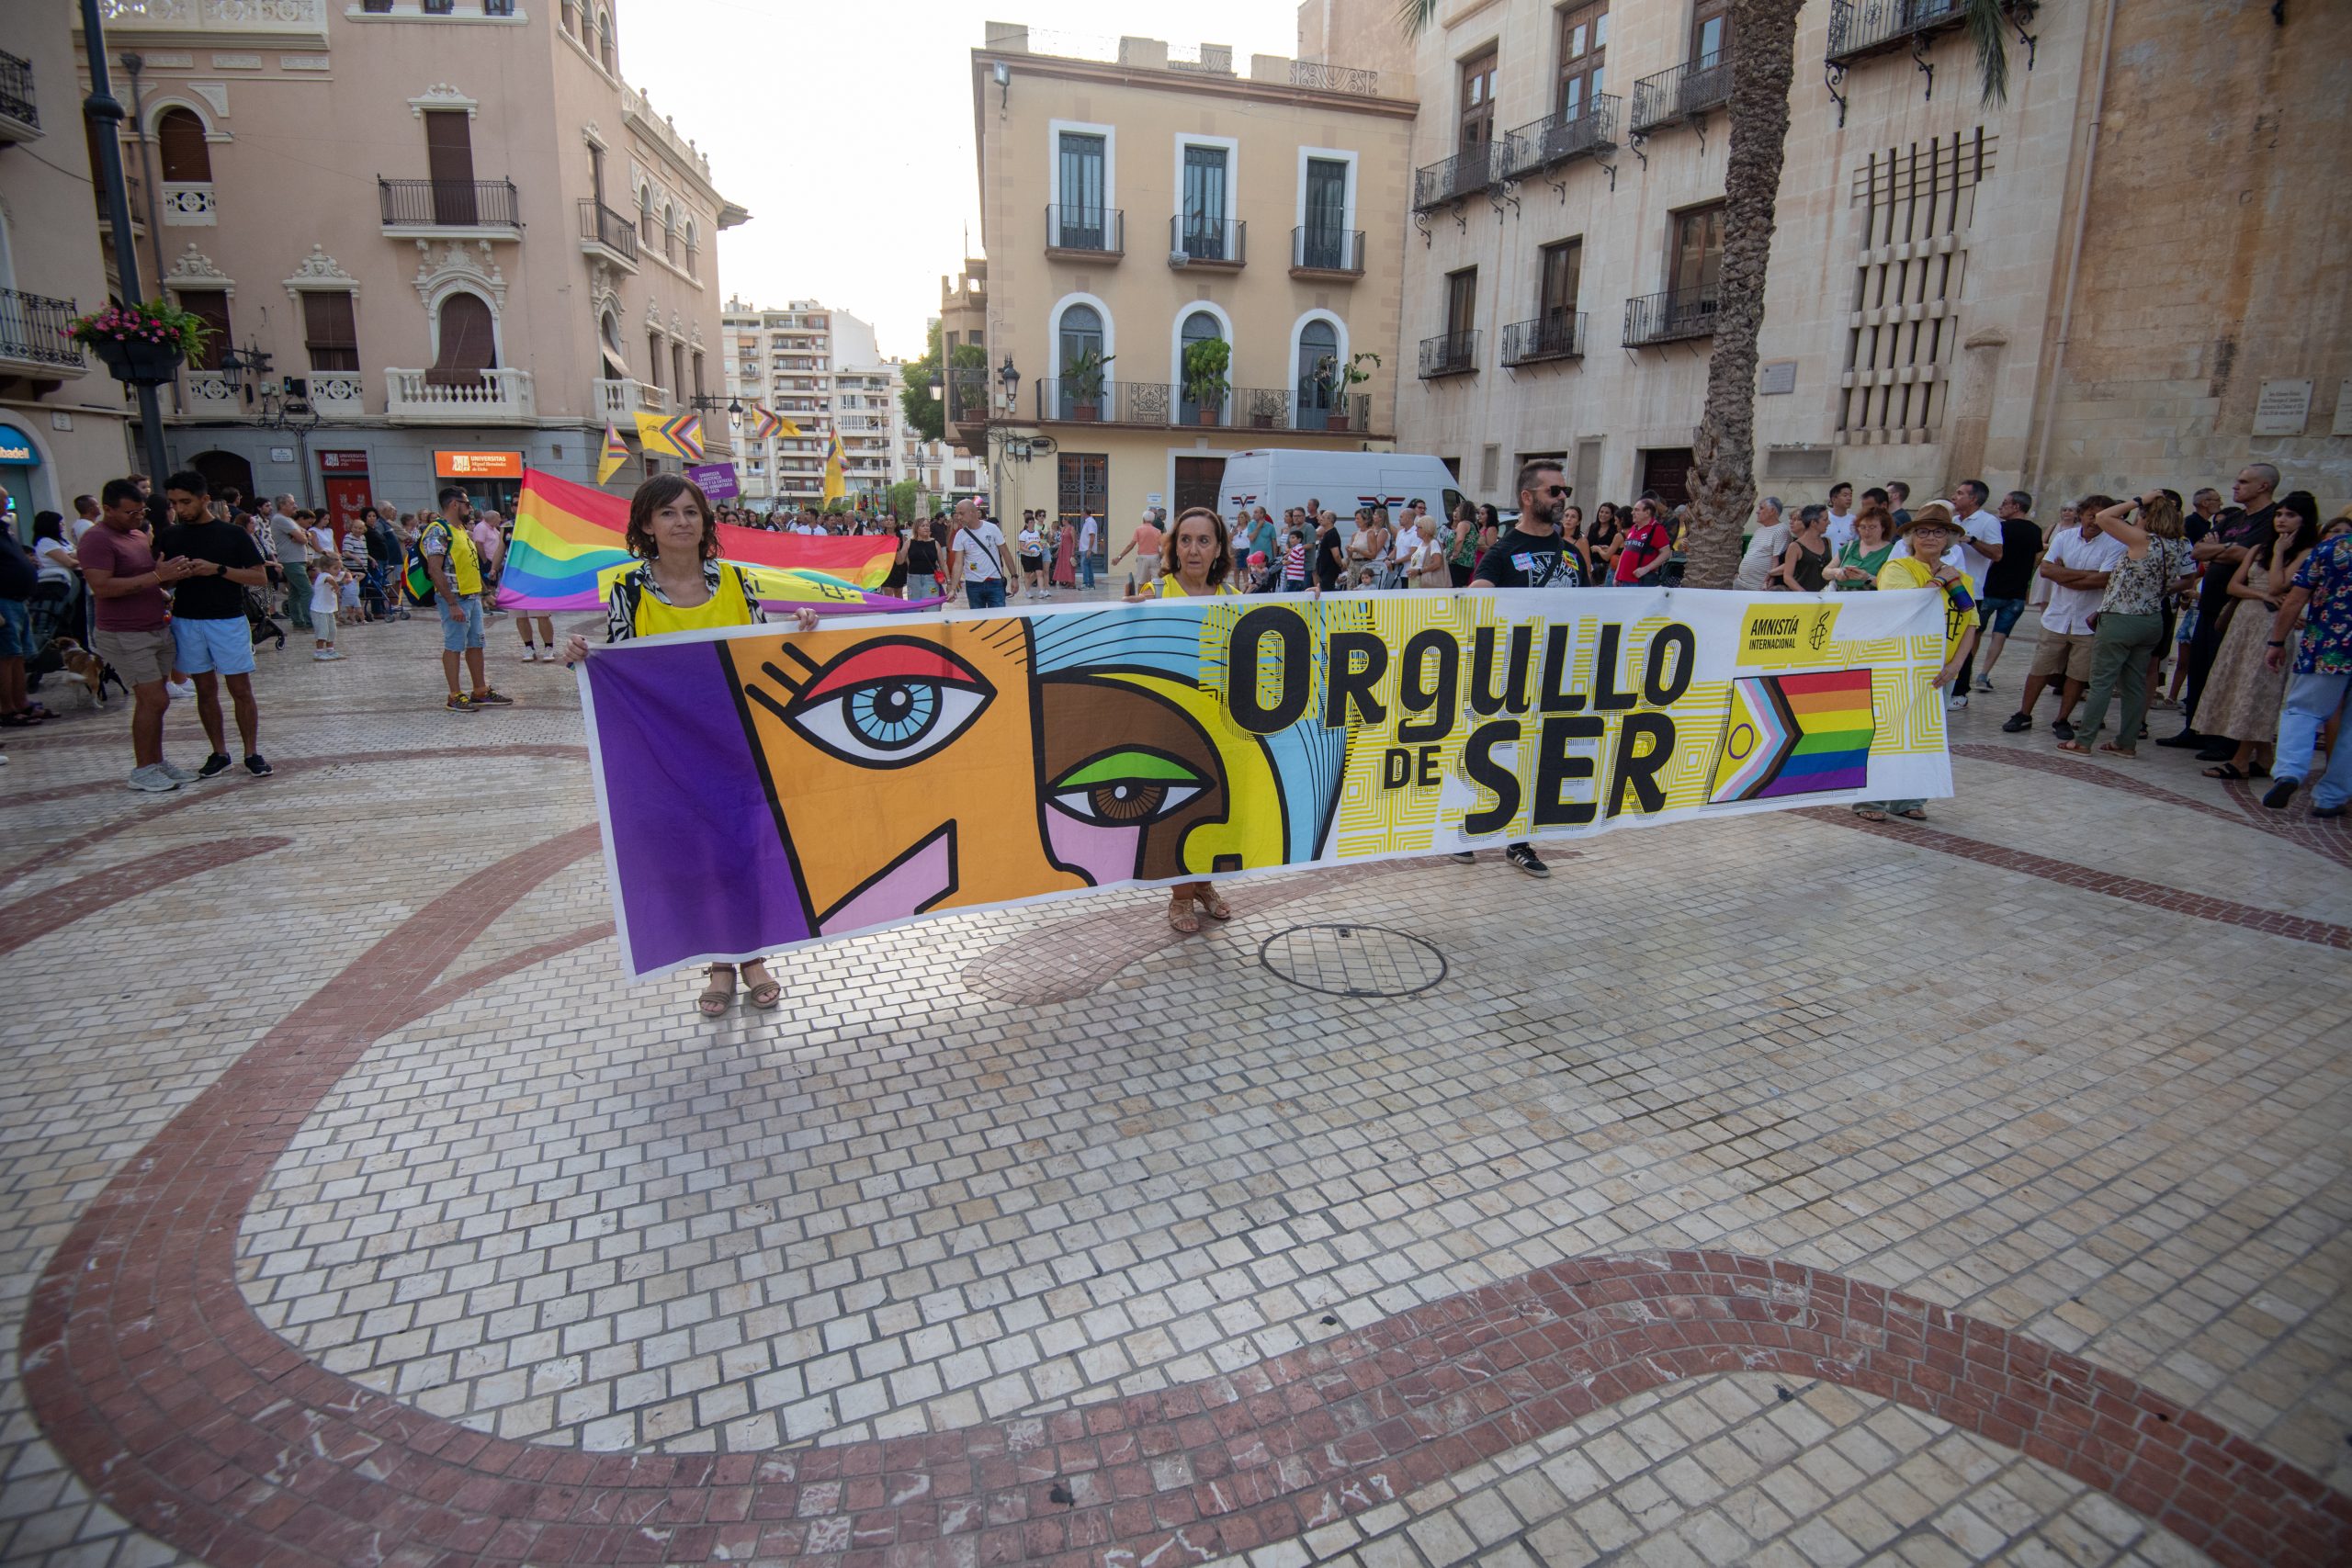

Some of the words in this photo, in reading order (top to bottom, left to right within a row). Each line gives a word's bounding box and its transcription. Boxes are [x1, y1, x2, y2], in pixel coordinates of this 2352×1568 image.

[1750, 615, 1800, 636] AMNISTÍA
[1748, 637, 1796, 650] INTERNACIONAL
[1384, 745, 1442, 790] DE
[1464, 712, 1677, 835] SER
